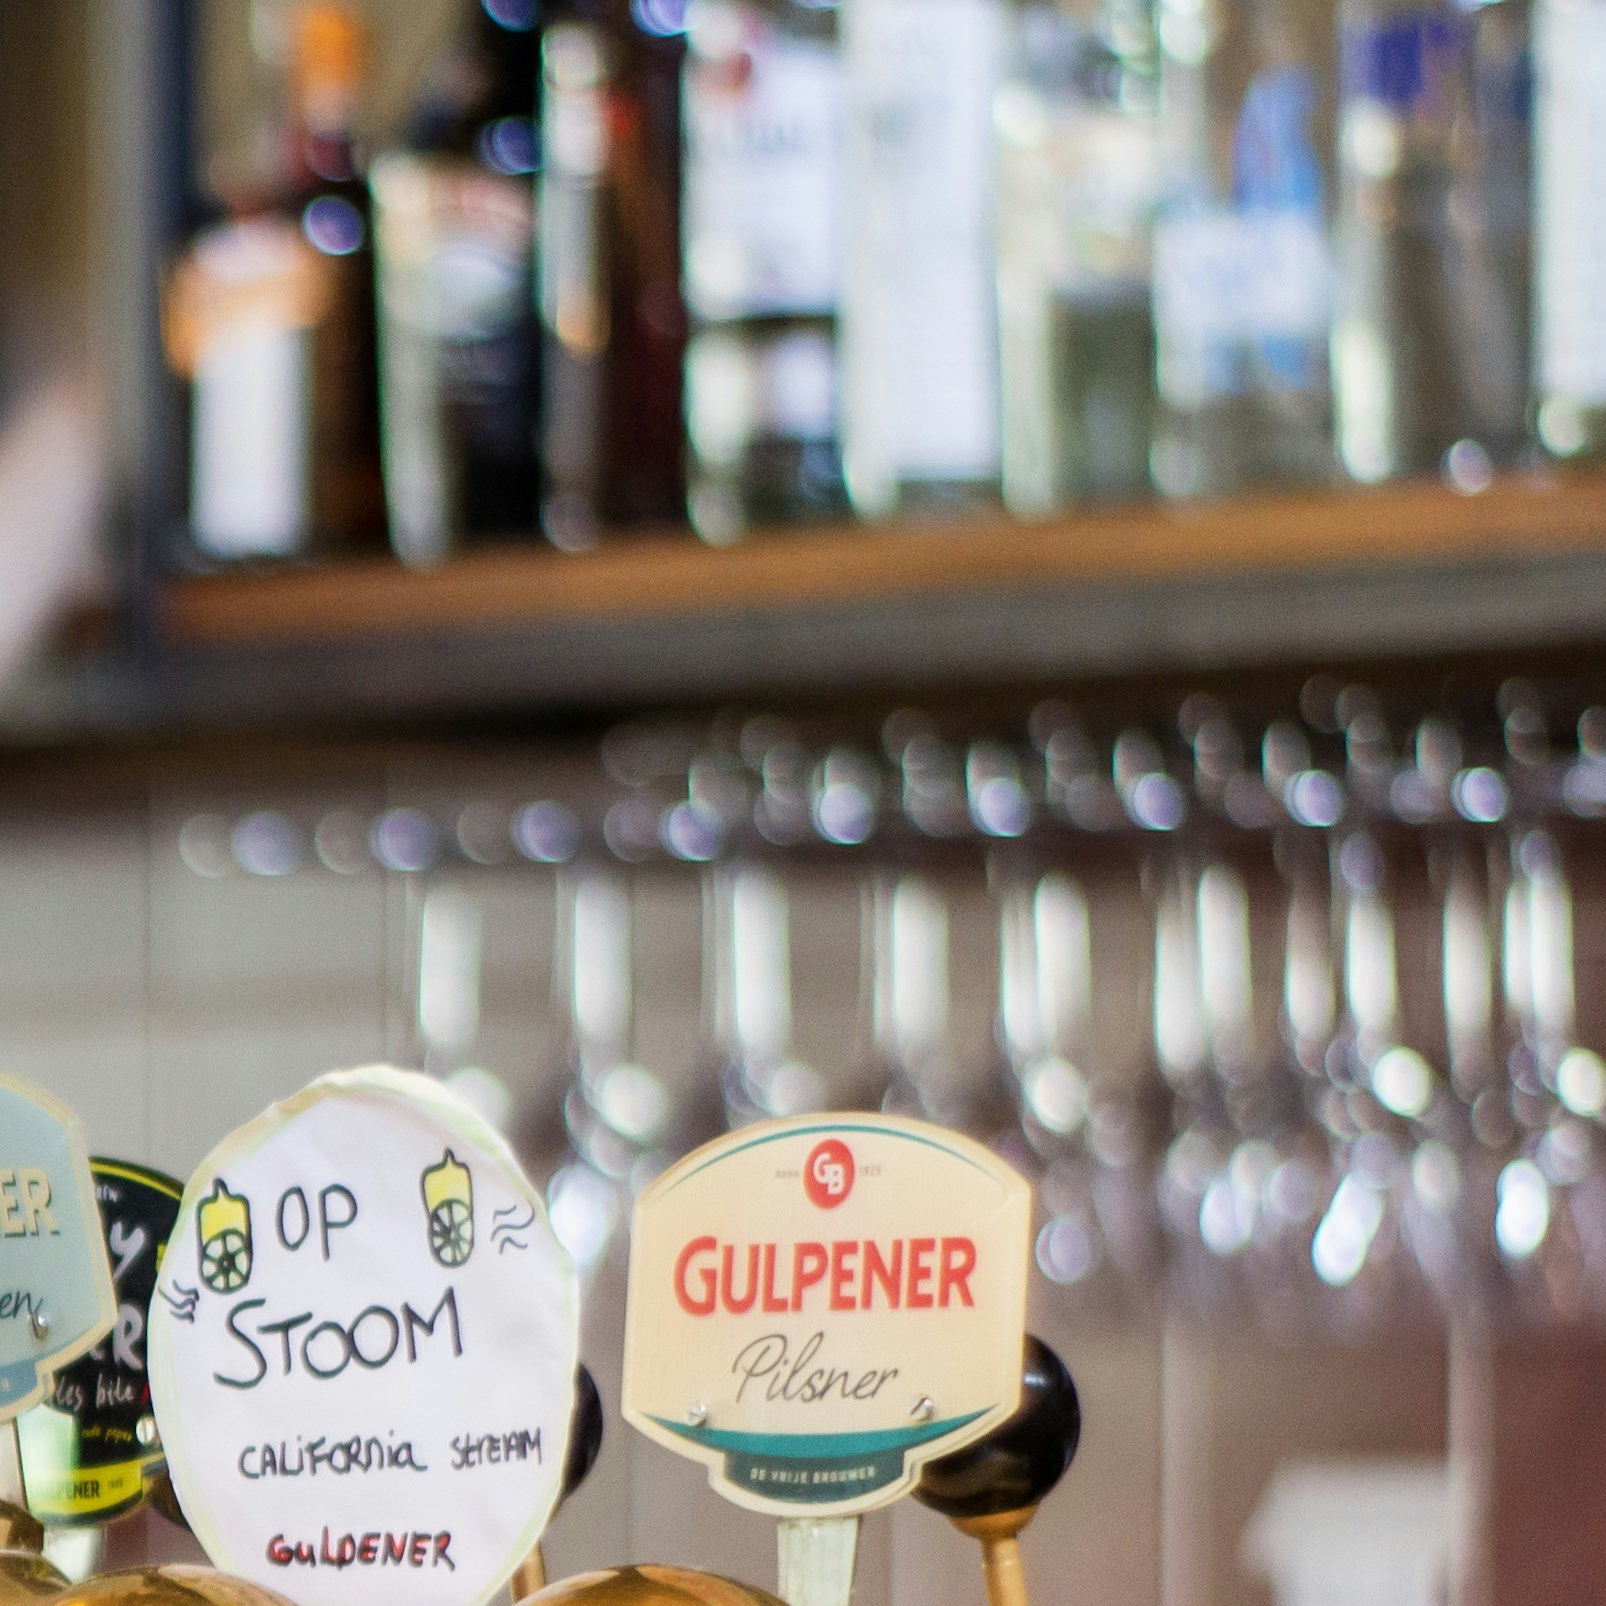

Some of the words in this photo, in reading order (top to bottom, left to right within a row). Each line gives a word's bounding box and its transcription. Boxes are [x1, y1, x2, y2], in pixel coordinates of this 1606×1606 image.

[275, 1183, 358, 1261] OP
[673, 1235, 978, 1317] GULPENER
[213, 1285, 463, 1390] STOOM
[731, 1330, 899, 1404] Pilsner
